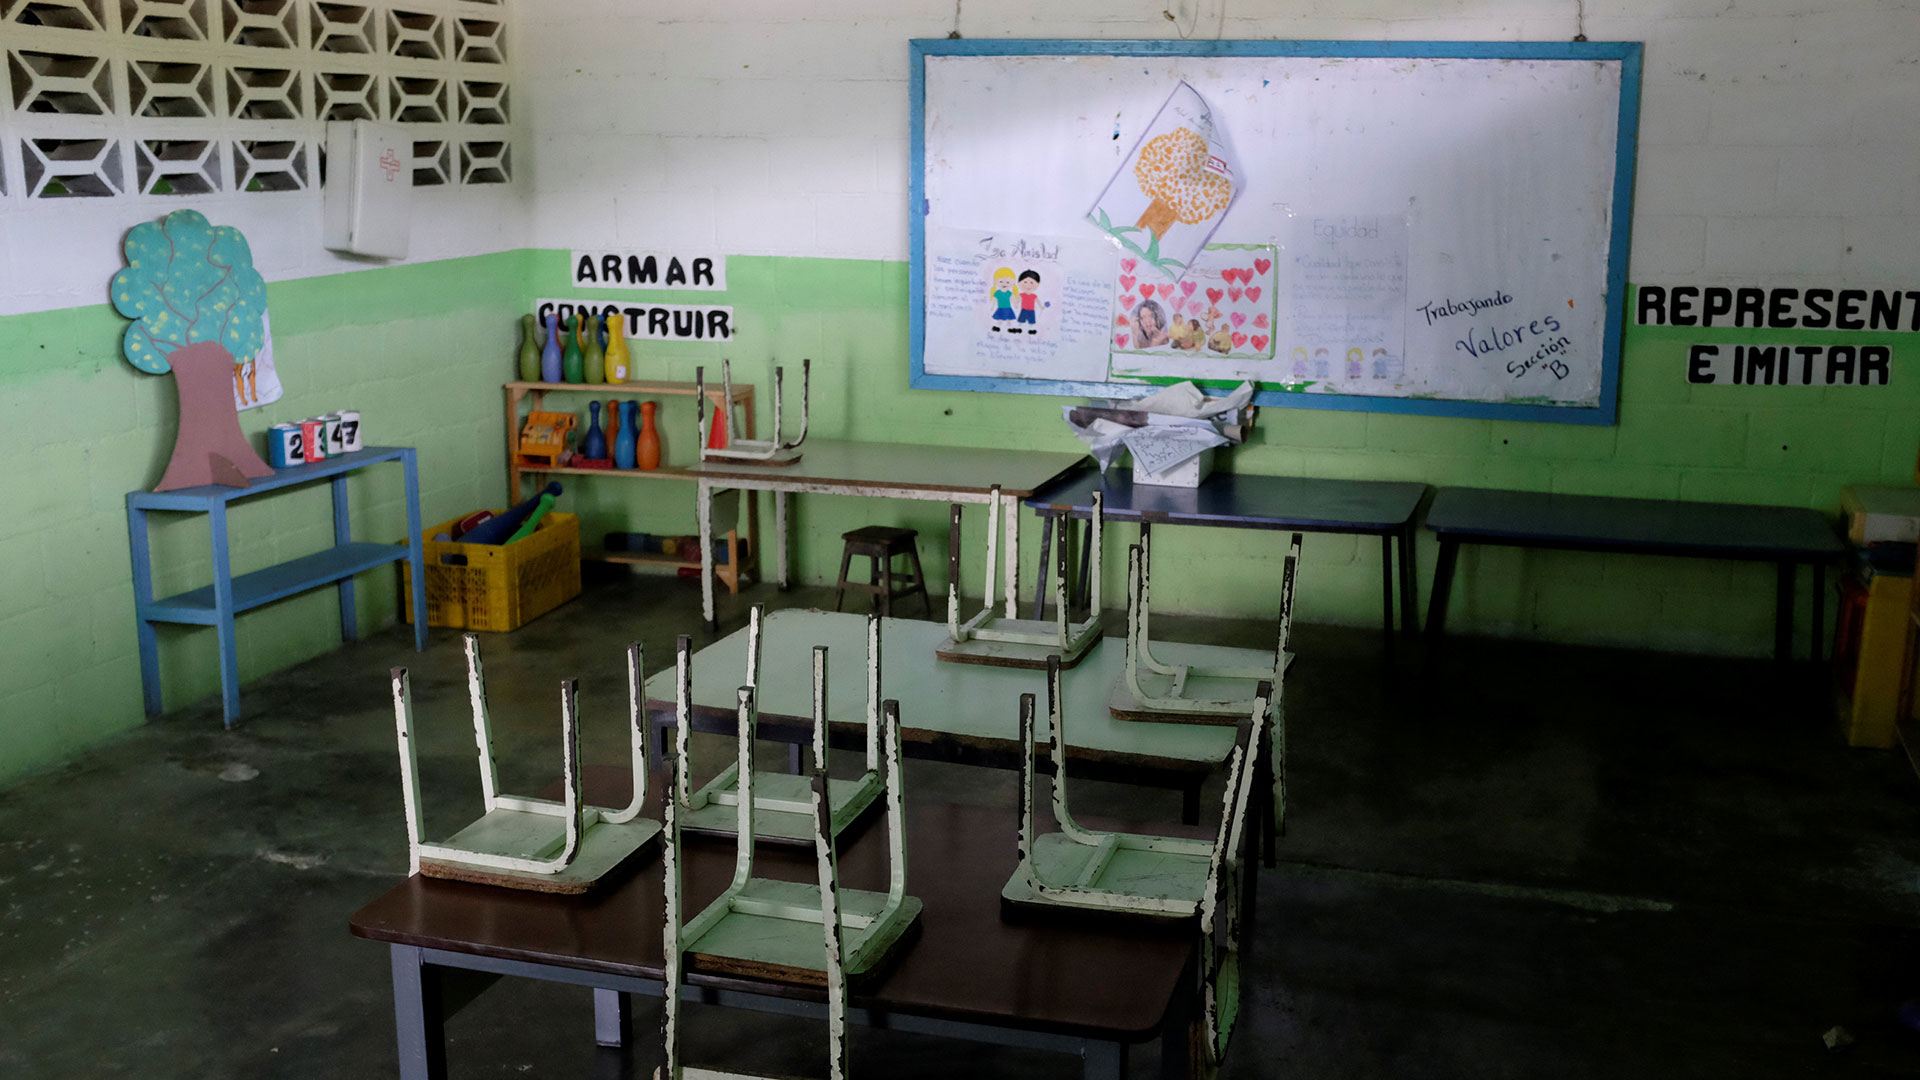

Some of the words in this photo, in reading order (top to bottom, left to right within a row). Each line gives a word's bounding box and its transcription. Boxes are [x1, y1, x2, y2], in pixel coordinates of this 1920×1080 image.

[1312, 216, 1378, 249] Equidad
[577, 254, 715, 287] ARMAR
[1416, 290, 1513, 326] Trabajando
[1455, 315, 1561, 359] Valores
[1687, 345, 1720, 384] E
[1732, 345, 1890, 386] IMITAR
[289, 433, 304, 459] 2
[331, 423, 343, 449] 4
[342, 420, 359, 445] 7
